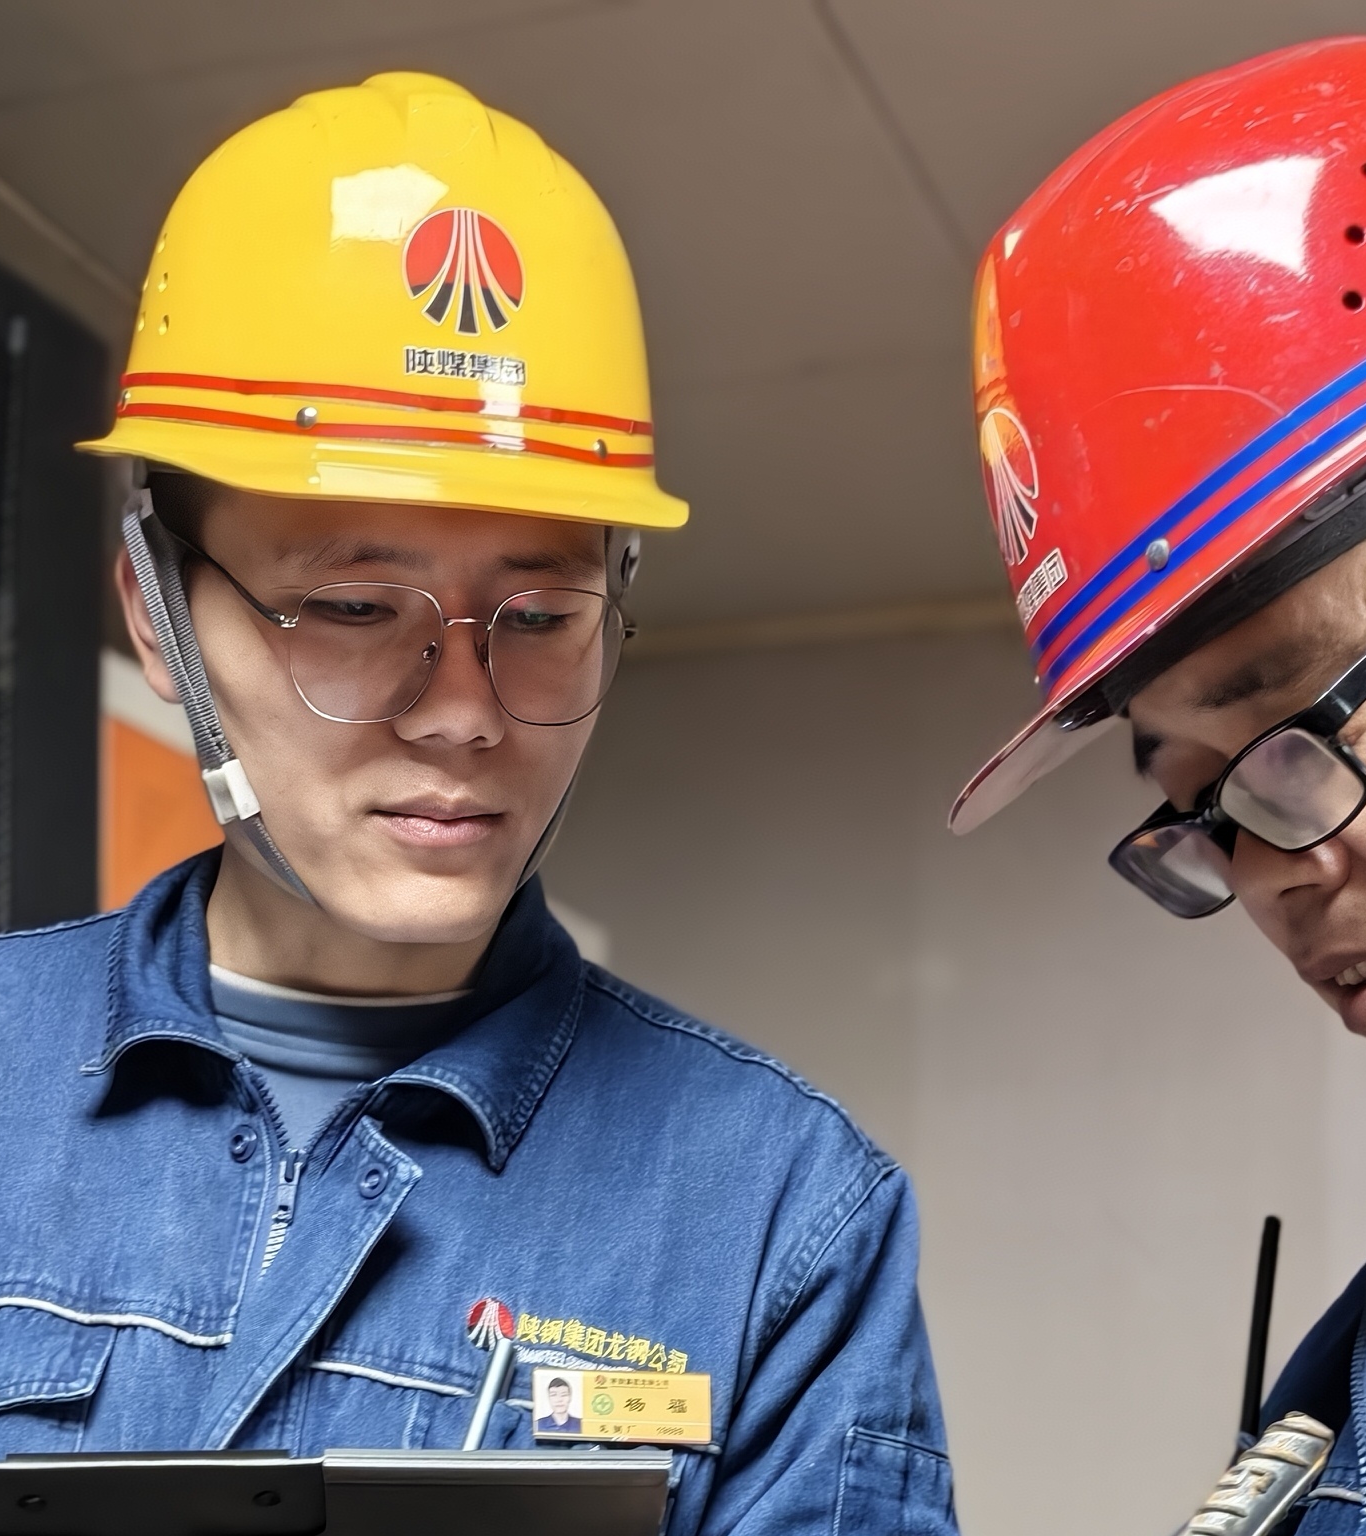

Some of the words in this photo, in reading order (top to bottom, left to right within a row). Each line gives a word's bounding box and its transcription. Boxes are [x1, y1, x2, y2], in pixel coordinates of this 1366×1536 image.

[516, 1312, 689, 1374] 陕钢集团龙钢公司
